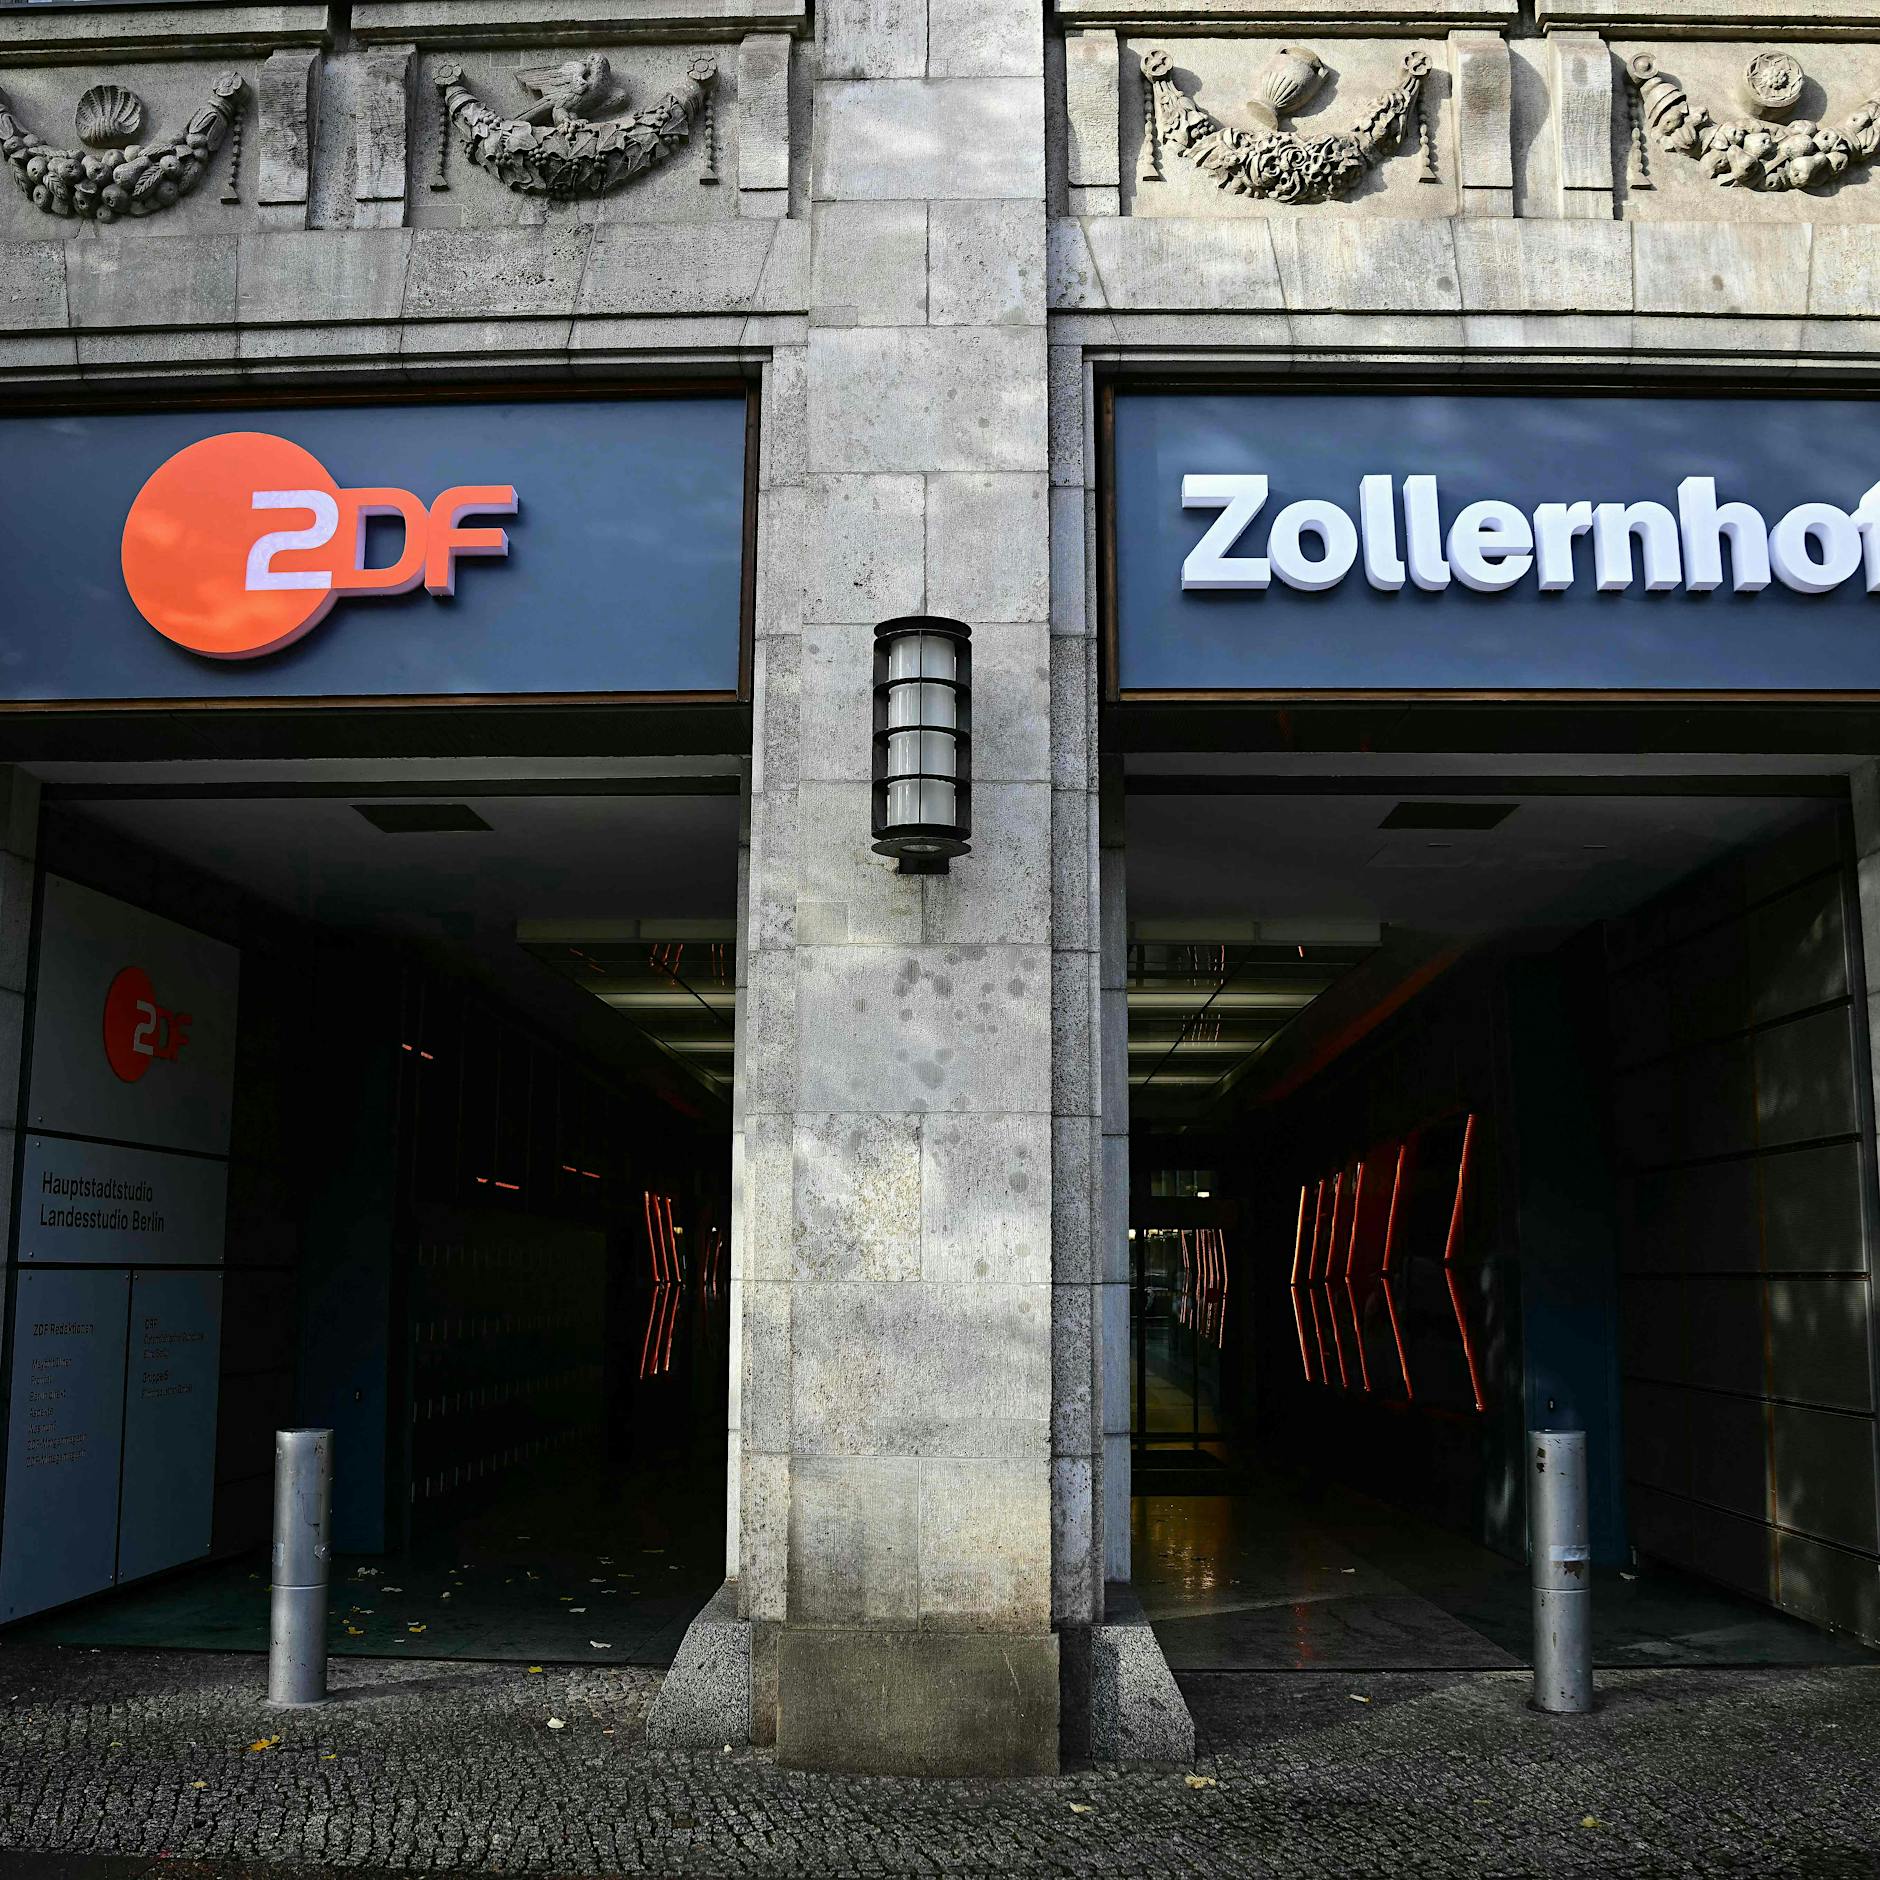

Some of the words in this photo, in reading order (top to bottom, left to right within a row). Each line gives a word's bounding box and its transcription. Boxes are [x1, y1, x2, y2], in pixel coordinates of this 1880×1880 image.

[42, 1171, 153, 1203] Hauptstadtstudio
[40, 1204, 129, 1231] Landesstudio
[132, 1210, 165, 1233] Berlin
